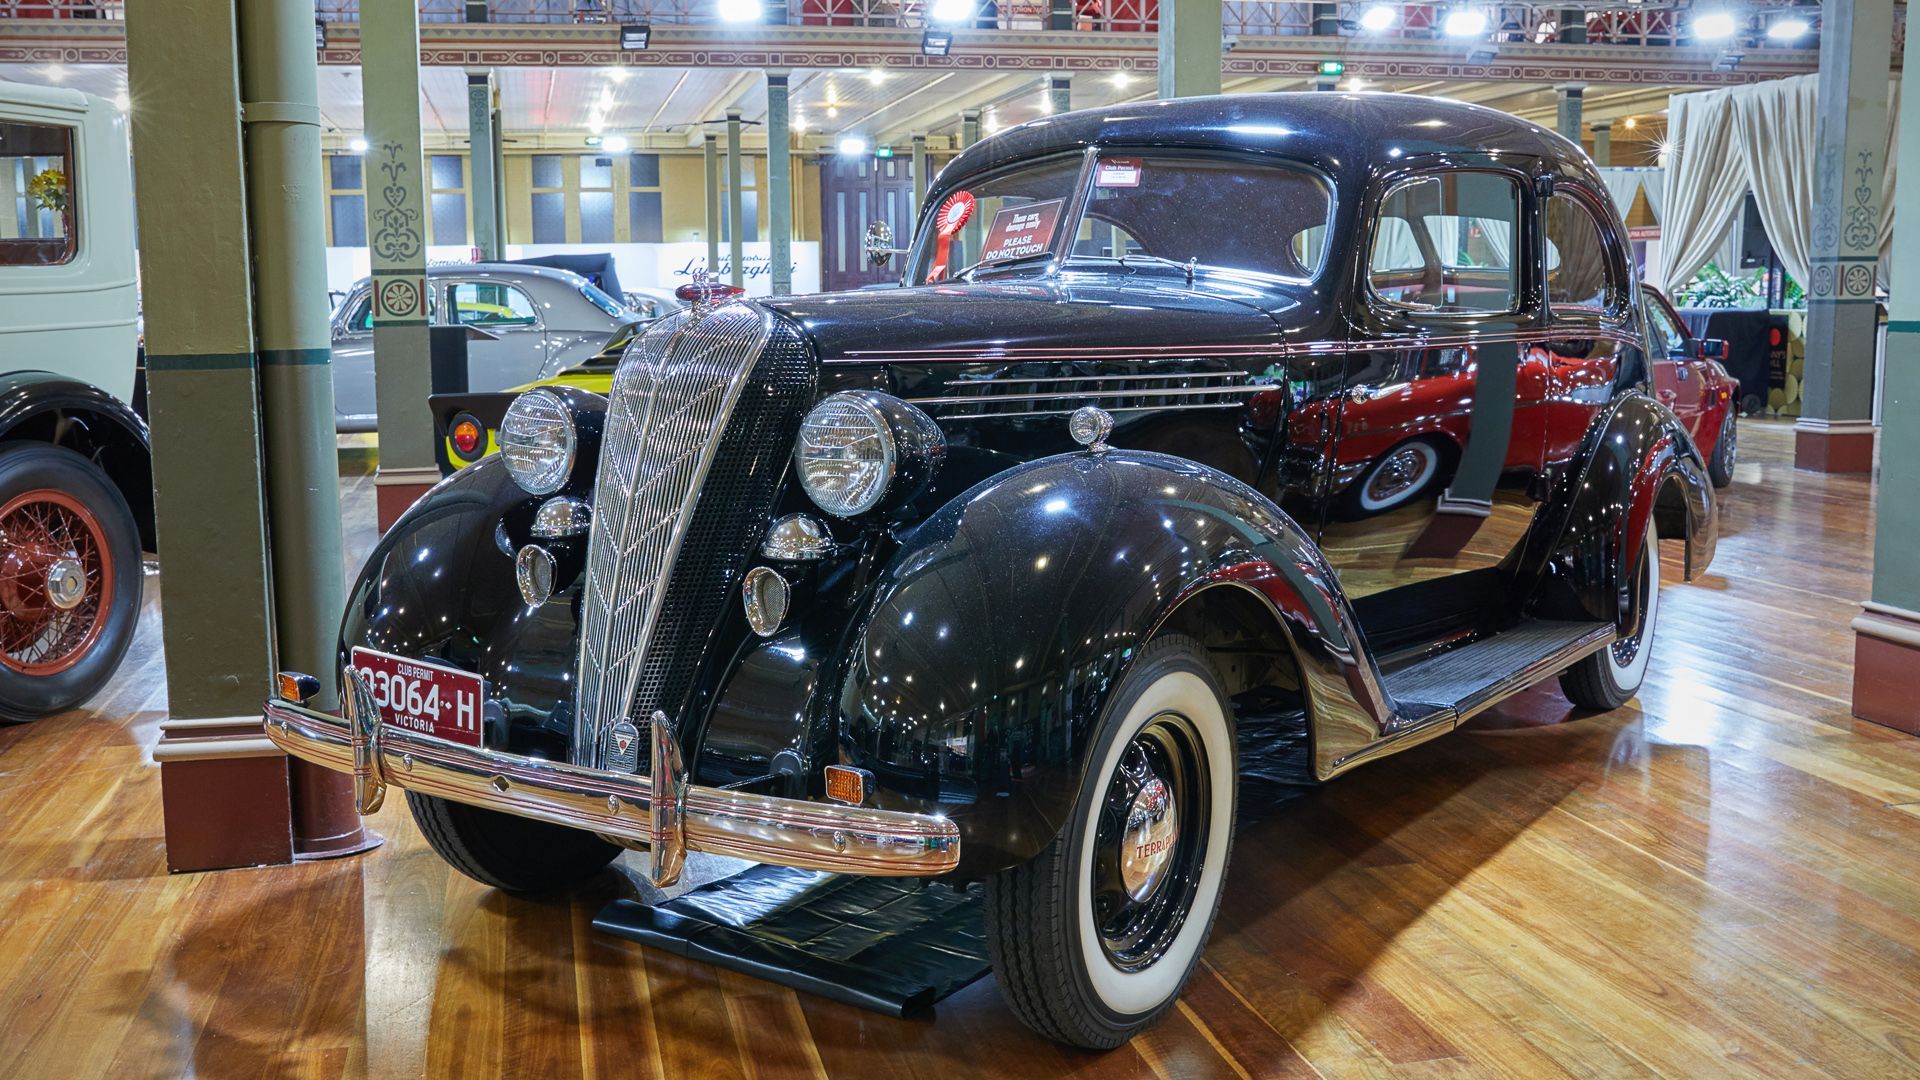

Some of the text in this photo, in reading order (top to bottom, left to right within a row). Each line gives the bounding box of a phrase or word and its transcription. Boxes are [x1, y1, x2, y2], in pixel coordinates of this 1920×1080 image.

[1005, 222, 1025, 232] damage
[1003, 235, 1033, 247] PLEASE
[986, 243, 1044, 259] DO NOT TOUCH
[397, 663, 434, 682] CLUB PERMIT
[394, 713, 435, 734] VICTORIA
